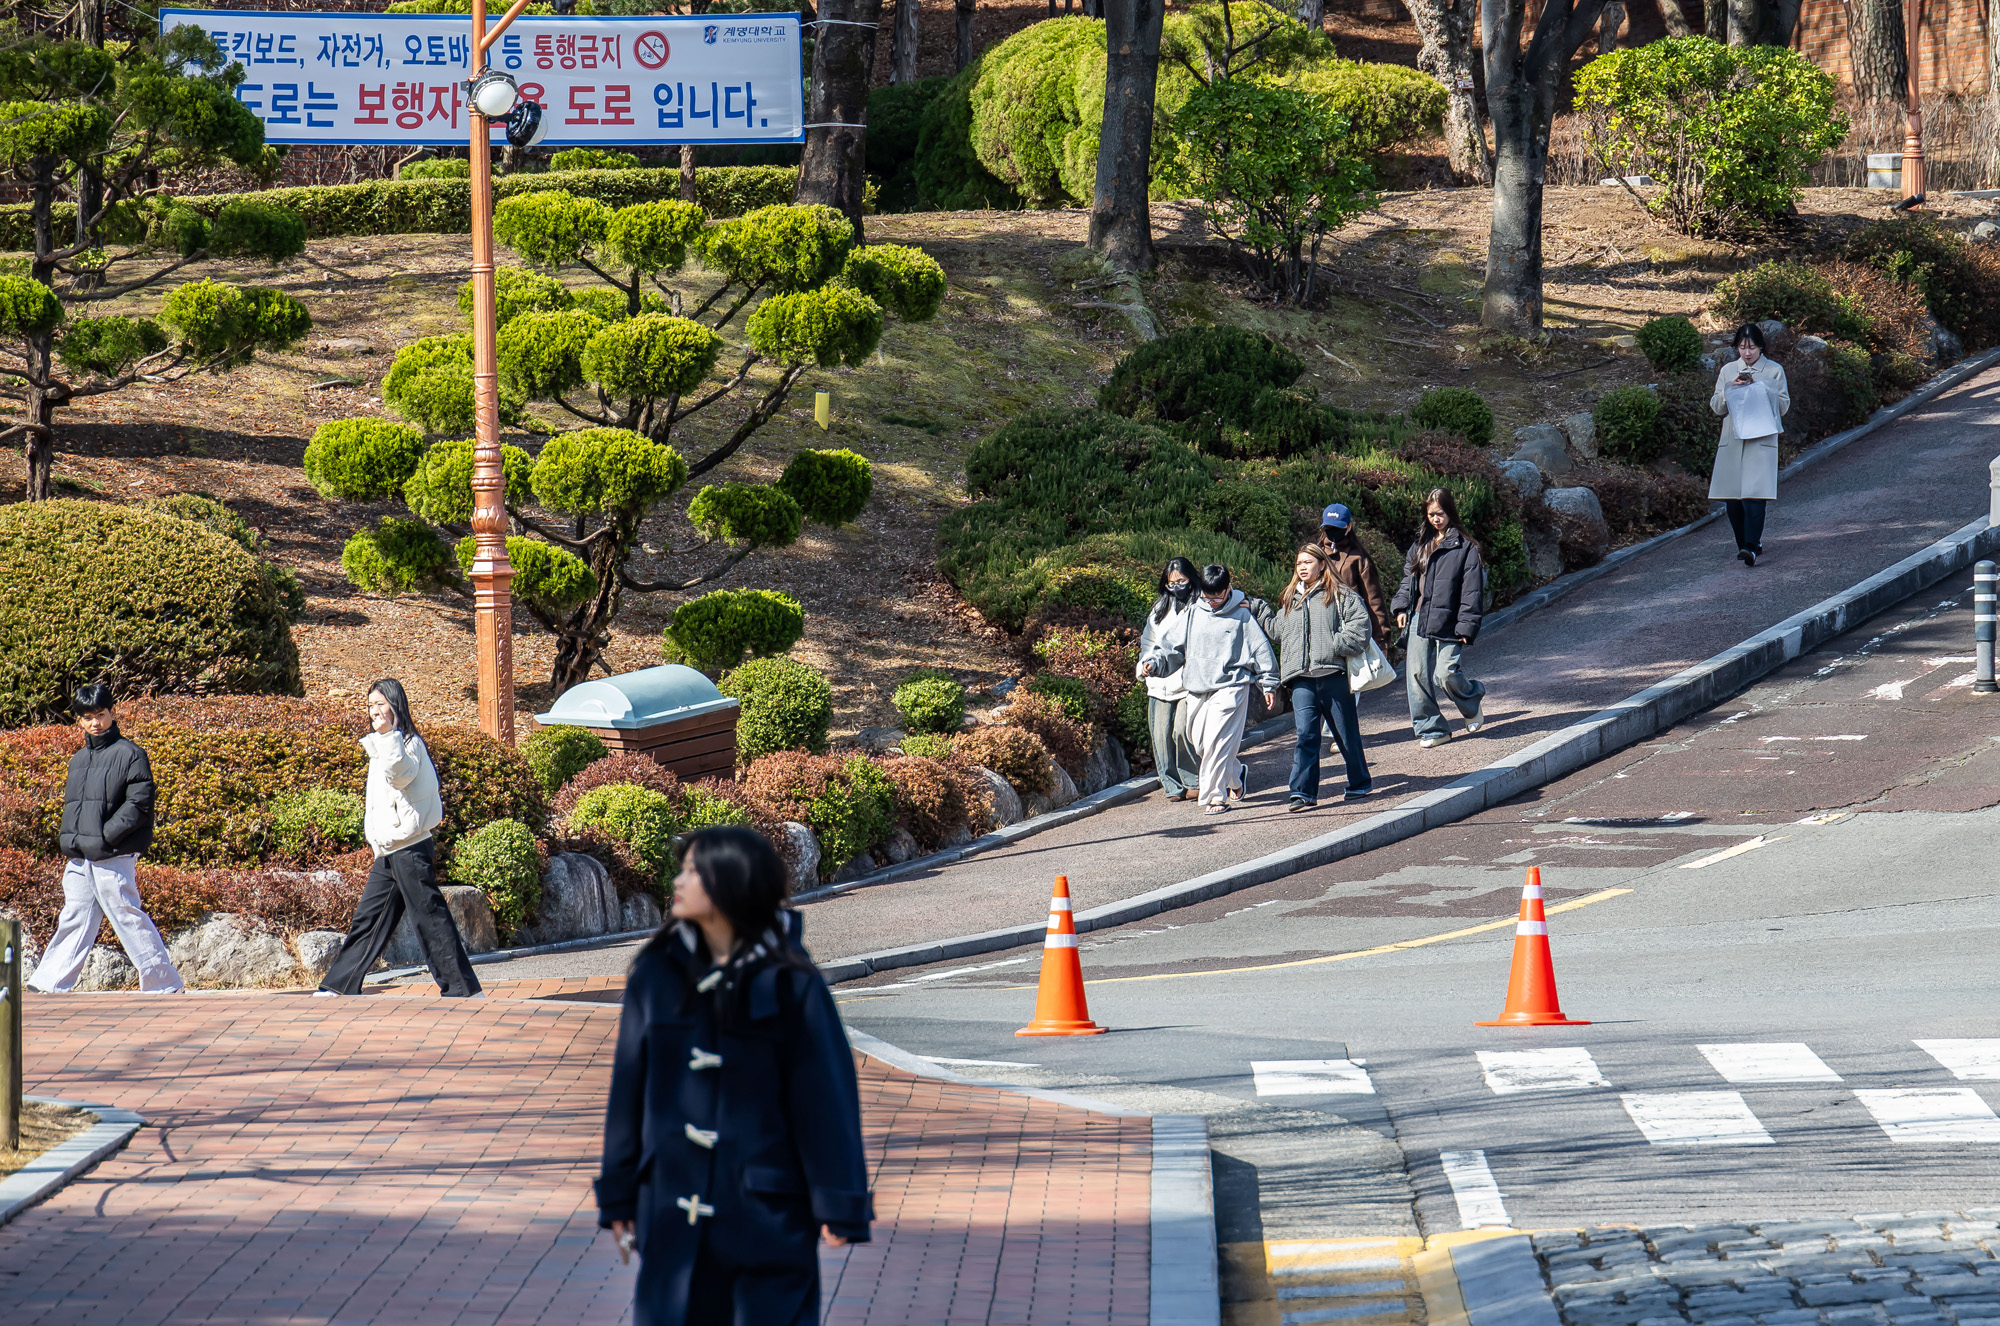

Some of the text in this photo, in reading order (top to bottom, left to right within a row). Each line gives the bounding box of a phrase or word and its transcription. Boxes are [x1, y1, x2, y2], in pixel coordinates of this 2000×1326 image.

[188, 31, 621, 70] 동킥보드, 자전거, 오토바 등 통행금지
[723, 26, 786, 37] 계명대학교
[236, 82, 768, 130] 도로는 보행자 도로 입니다.
